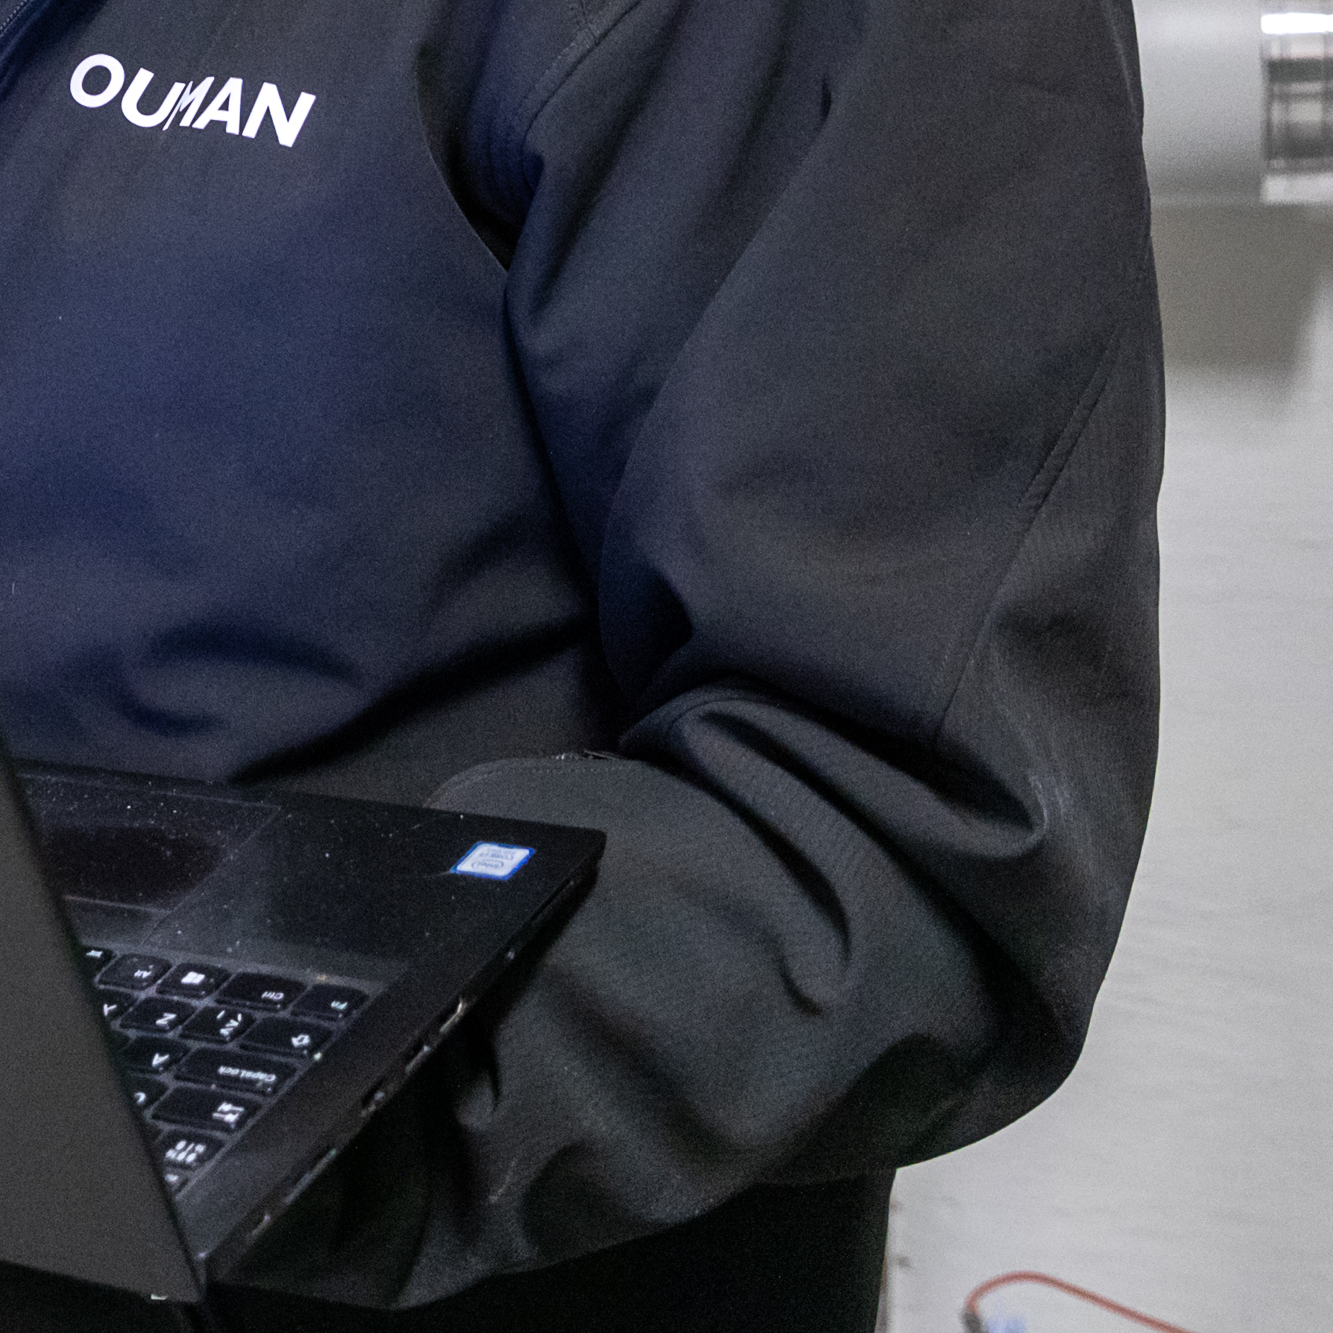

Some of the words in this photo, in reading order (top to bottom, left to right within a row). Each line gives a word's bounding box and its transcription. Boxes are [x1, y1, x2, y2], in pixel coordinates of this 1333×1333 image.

[69, 53, 316, 148] OUMAN
[261, 991, 285, 1001] Ctrl
[156, 1012, 177, 1026] Z
[151, 1052, 170, 1067] A
[217, 1065, 277, 1083] CapsLock
